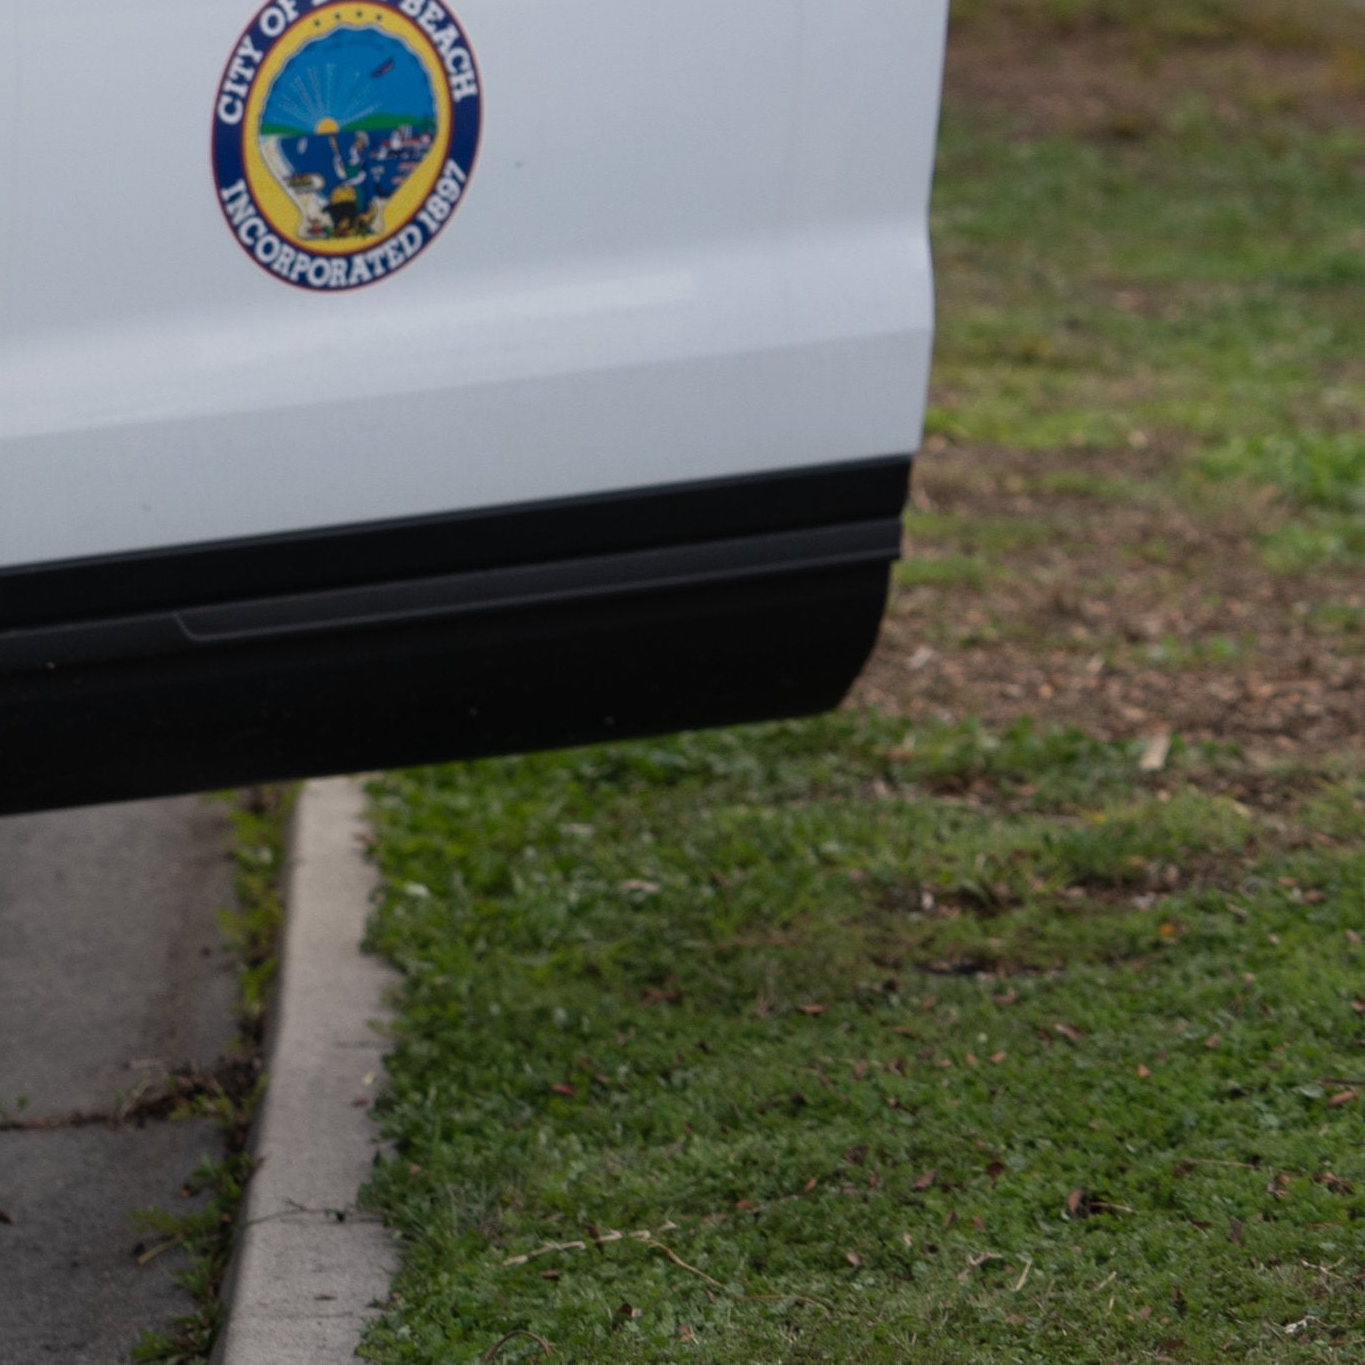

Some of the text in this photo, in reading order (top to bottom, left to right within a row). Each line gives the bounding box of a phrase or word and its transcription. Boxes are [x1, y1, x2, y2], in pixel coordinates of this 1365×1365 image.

[217, 33, 264, 125] CITY
[221, 159, 468, 288] INCORPORATED 1897
